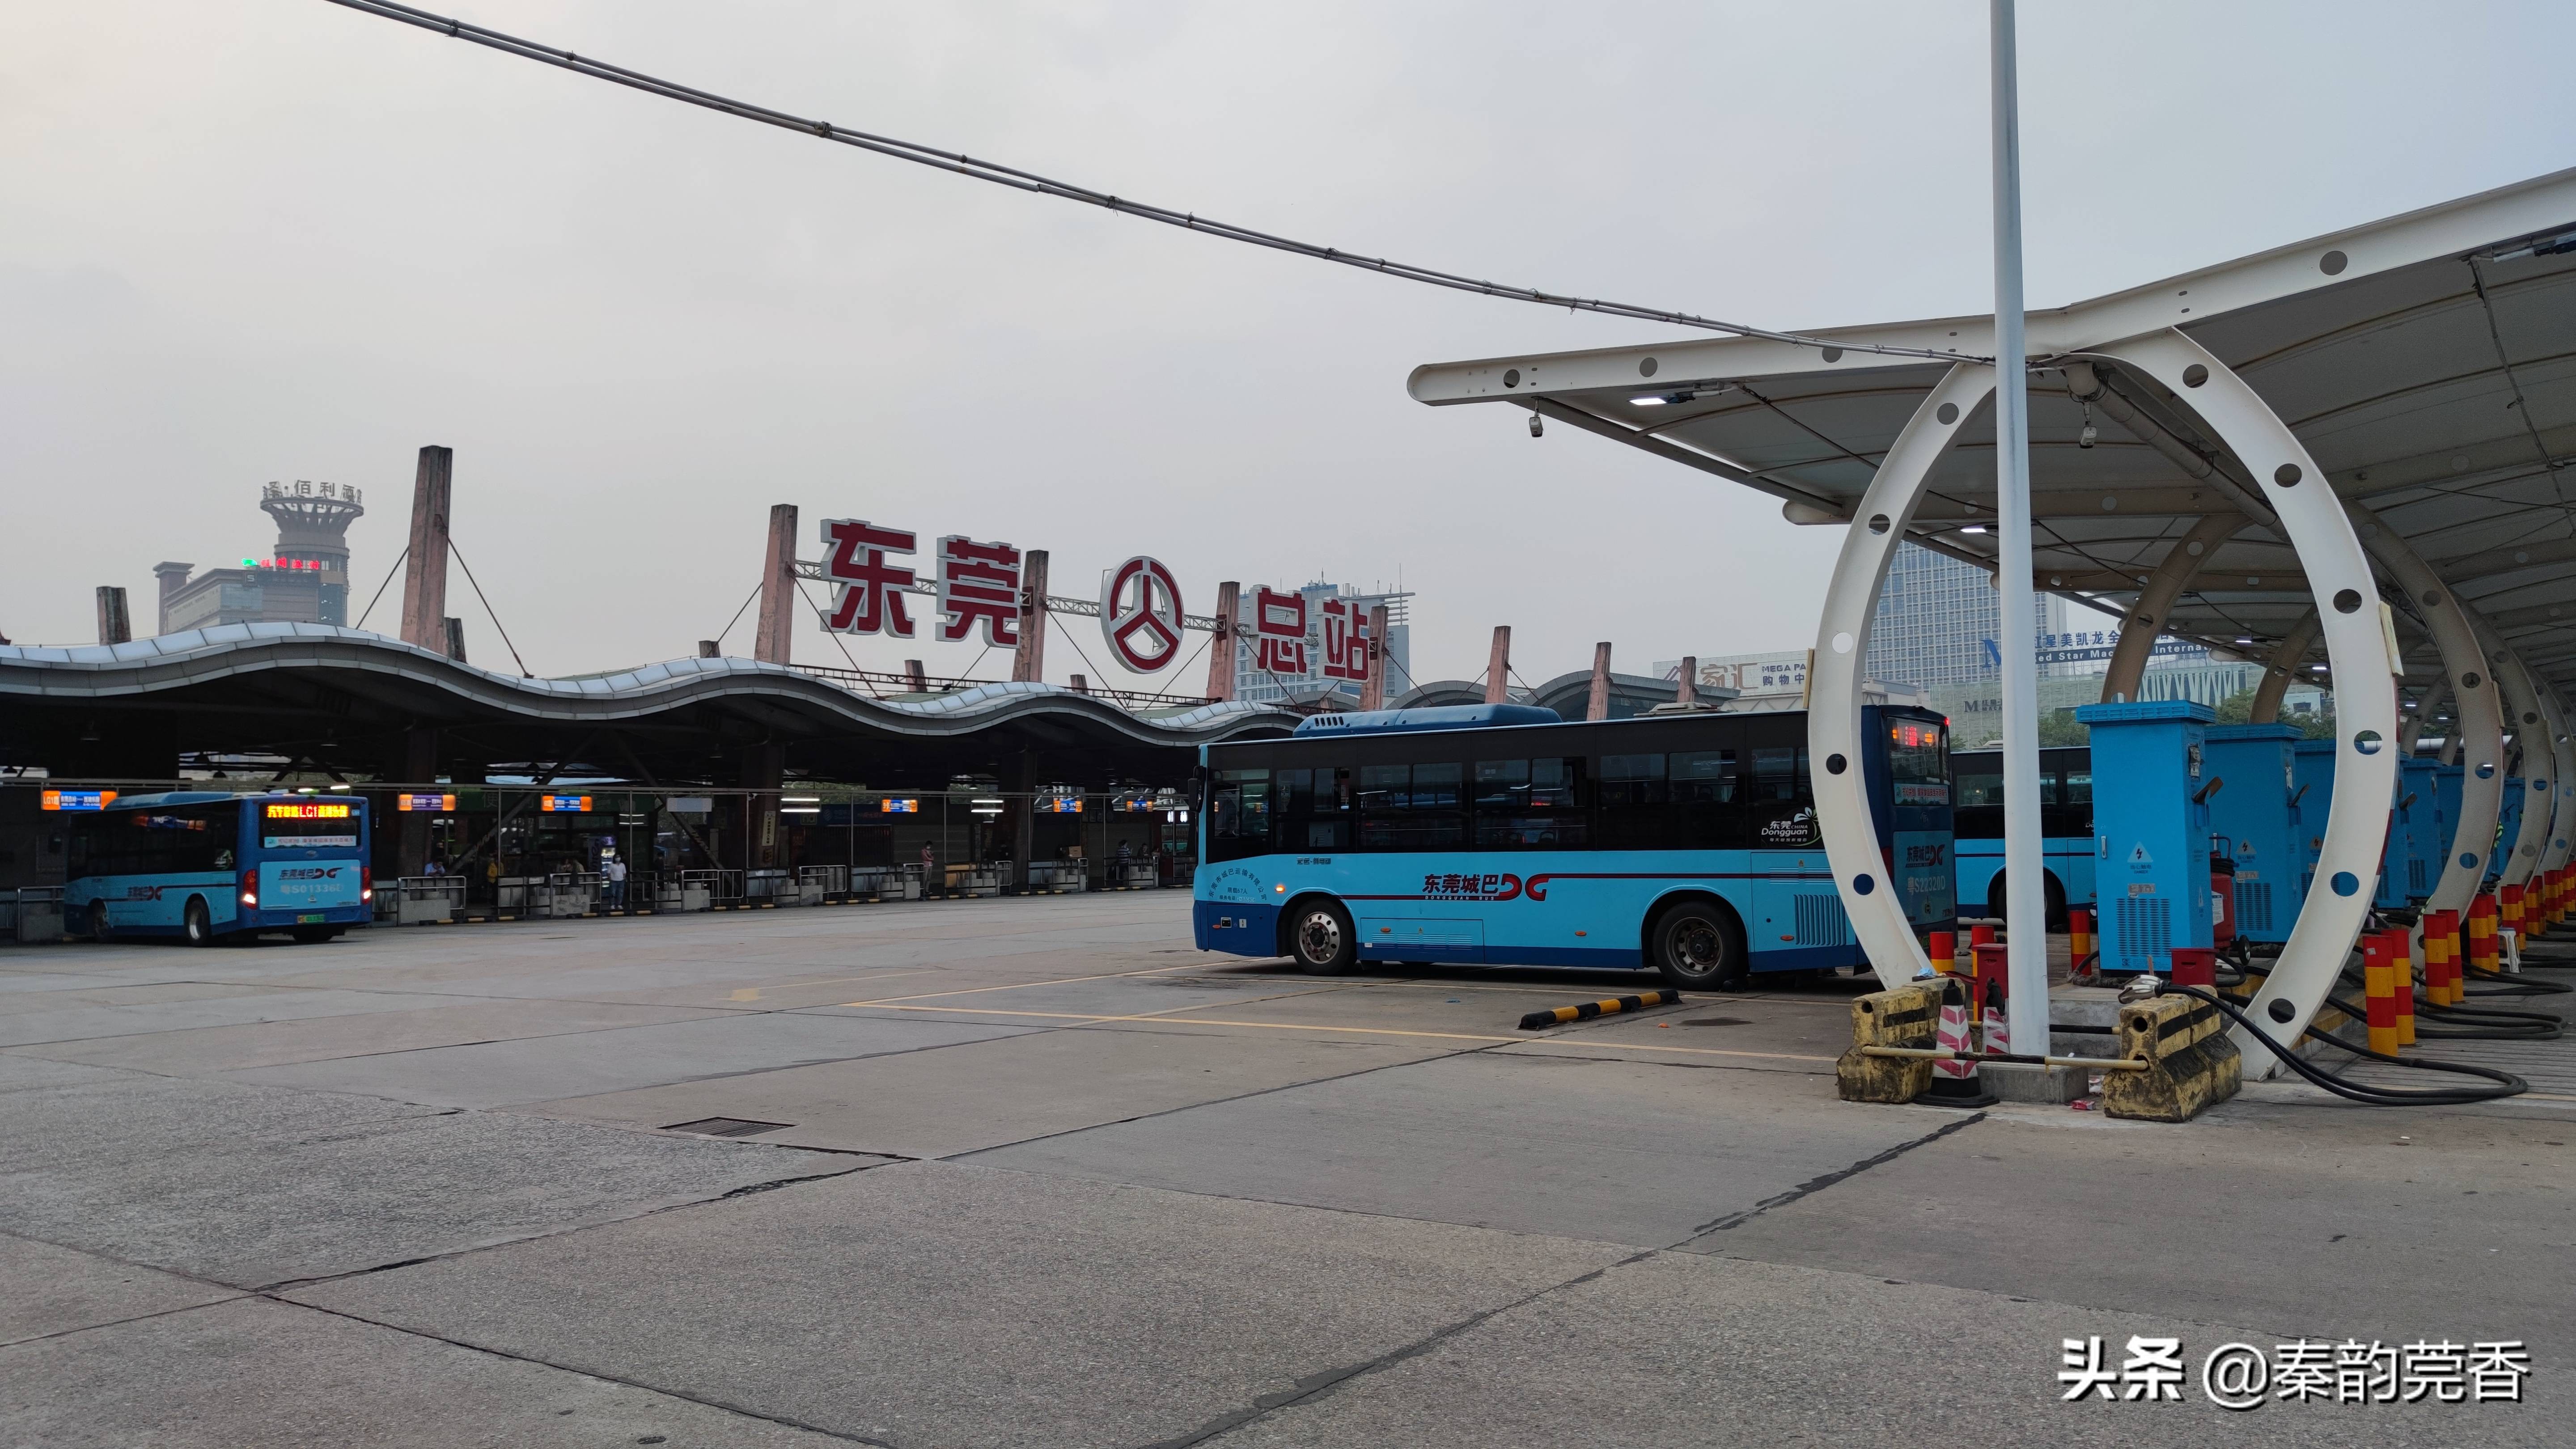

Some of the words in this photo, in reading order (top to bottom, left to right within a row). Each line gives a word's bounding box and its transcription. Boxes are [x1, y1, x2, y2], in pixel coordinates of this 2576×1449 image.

[821, 518, 1021, 648] 东莞
[1252, 585, 1369, 682] 总站
[2036, 653, 2052, 662] ed
[2059, 652, 2083, 661] Star
[1762, 664, 1791, 673] MEGA
[1763, 673, 1805, 686] 购物中
[1761, 828, 1808, 837] Dongguan
[1770, 821, 1792, 830] 东莞
[1907, 846, 1930, 862] 东莞城巴
[1208, 868, 1267, 901] 东莞市城巴运输有限公司
[1422, 873, 1499, 894] 东莞城巴
[1907, 875, 1945, 895] 粤S22320D
